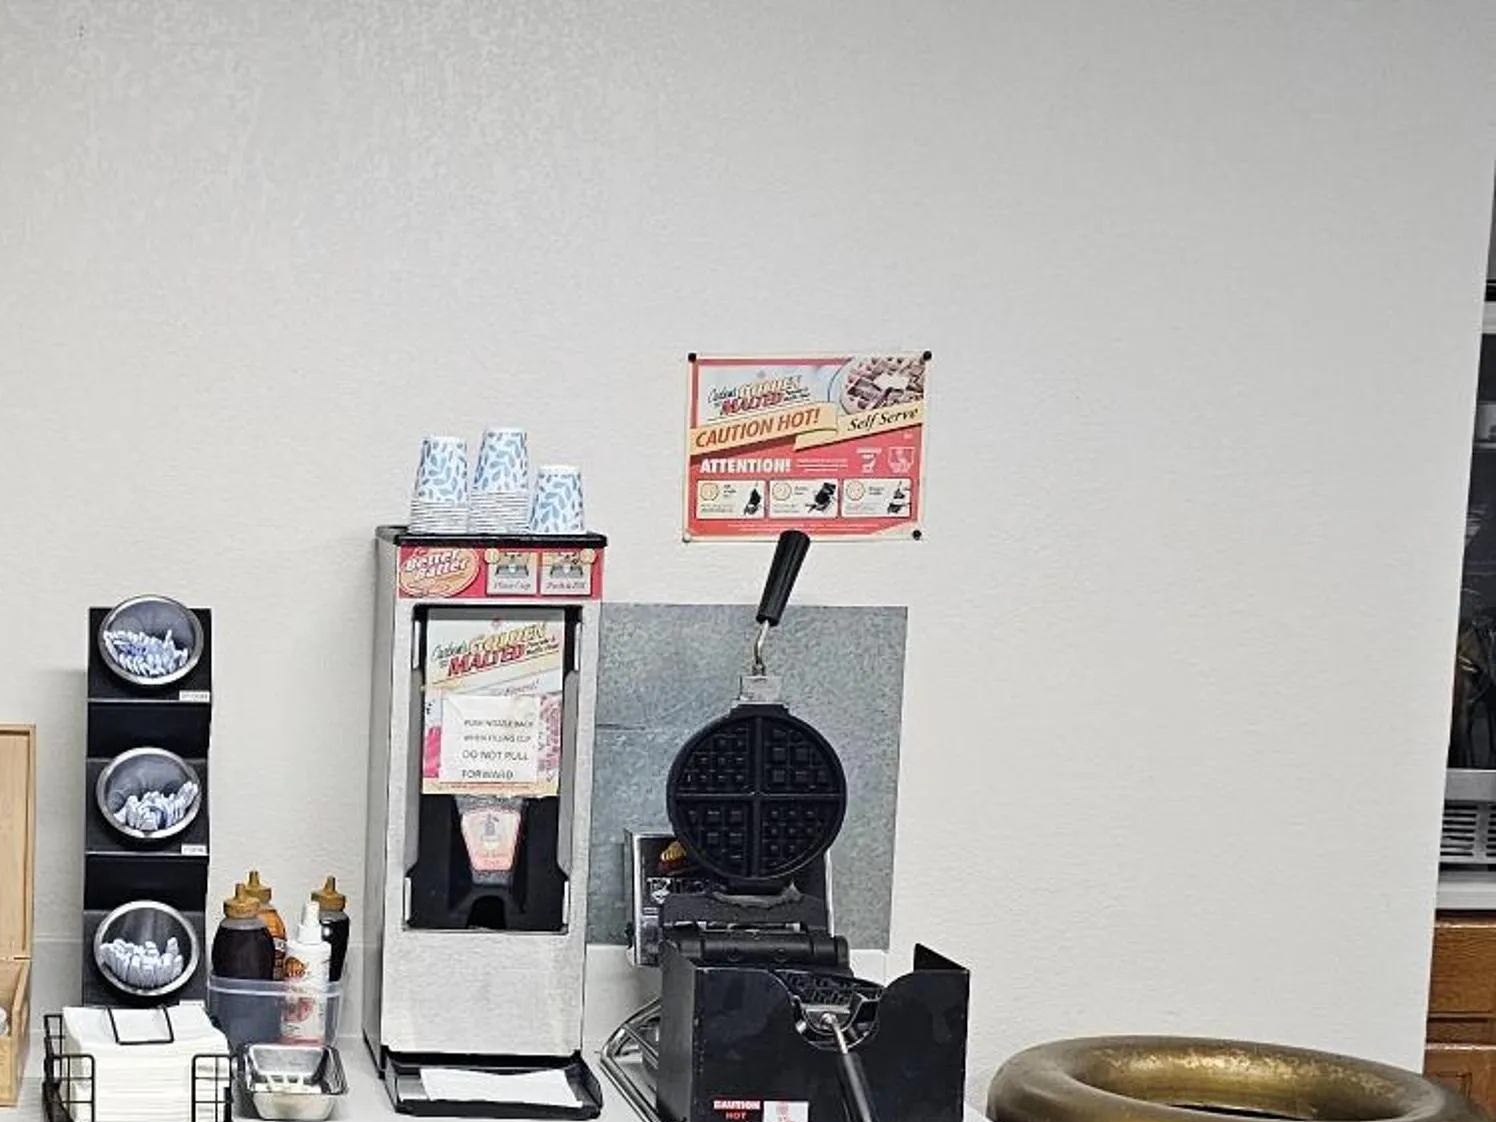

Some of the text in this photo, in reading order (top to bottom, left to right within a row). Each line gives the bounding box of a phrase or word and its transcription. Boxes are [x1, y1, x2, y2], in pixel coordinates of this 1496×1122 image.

[695, 408, 821, 448] CAUTION HOT!
[847, 408, 919, 434] Self Serve
[699, 457, 791, 474] ATTENTION!
[405, 550, 460, 573] Better
[414, 559, 468, 580] Batter
[448, 641, 526, 677] MALTED
[513, 719, 534, 727] BACK
[462, 749, 529, 761] DO NOT PULL
[461, 769, 514, 779] FORWARD
[713, 1100, 761, 1110] CAUTION
